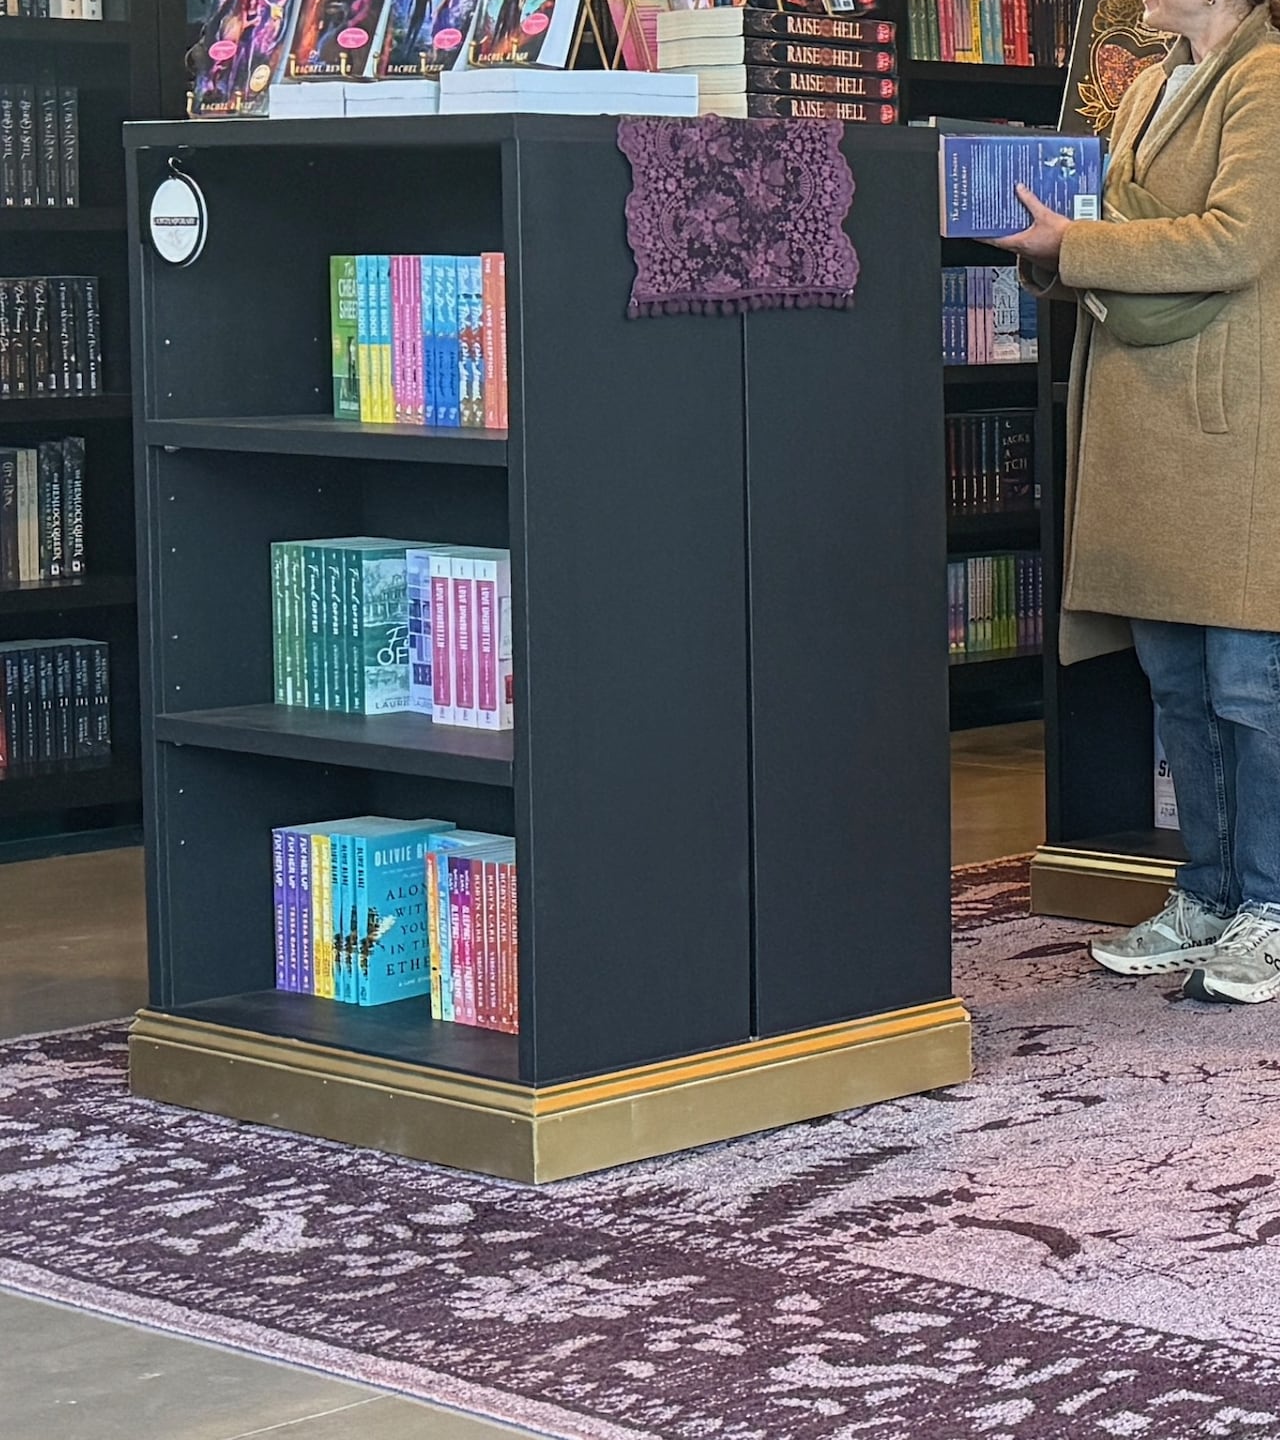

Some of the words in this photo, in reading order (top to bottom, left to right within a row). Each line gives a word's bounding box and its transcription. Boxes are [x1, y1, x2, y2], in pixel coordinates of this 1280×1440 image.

[787, 15, 821, 35] RAISE
[833, 21, 862, 40] HELL
[787, 45, 821, 65] RAISE
[832, 50, 862, 68] HELL
[387, 65, 416, 74] RACHEL
[791, 72, 824, 92] RAISE
[836, 77, 866, 95] HELL
[791, 99, 825, 118] RAISE
[836, 103, 866, 120] HELL
[951, 153, 959, 181] chooses
[951, 183, 959, 206] dream
[380, 284, 388, 306] RULE
[380, 308, 388, 336] BOOK
[486, 330, 494, 379] DECEPTION
[52, 484, 60, 526] HEMLOCK
[73, 480, 82, 524] HEMLOCK
[51, 527, 62, 560] QUEEN
[73, 525, 84, 557] QUEEN
[308, 564, 321, 601] Final
[328, 565, 341, 602] Final
[349, 567, 361, 604] Final
[436, 583, 444, 600] LOVE
[458, 585, 467, 603] LOVE
[481, 588, 490, 605] LOVE
[310, 601, 319, 633] OFFER
[331, 602, 339, 635] OFFER
[437, 602, 446, 648] UNWRITTEN
[458, 604, 468, 650] UNWRITTEN
[482, 607, 491, 653] UNWRITTEN
[273, 834, 283, 850] FIX
[287, 836, 296, 852] FIX
[300, 838, 308, 854] FIX
[275, 851, 284, 872] HER
[288, 853, 296, 873] HER
[301, 855, 309, 874] HER
[374, 846, 412, 867] OLIVIE
[276, 873, 284, 887] UP
[288, 874, 296, 889] UP
[301, 875, 309, 891] UP
[289, 906, 297, 934] TESSA
[277, 934, 285, 967] BAILEY
[290, 935, 298, 969] BAILEY
[390, 941, 405, 955] IN
